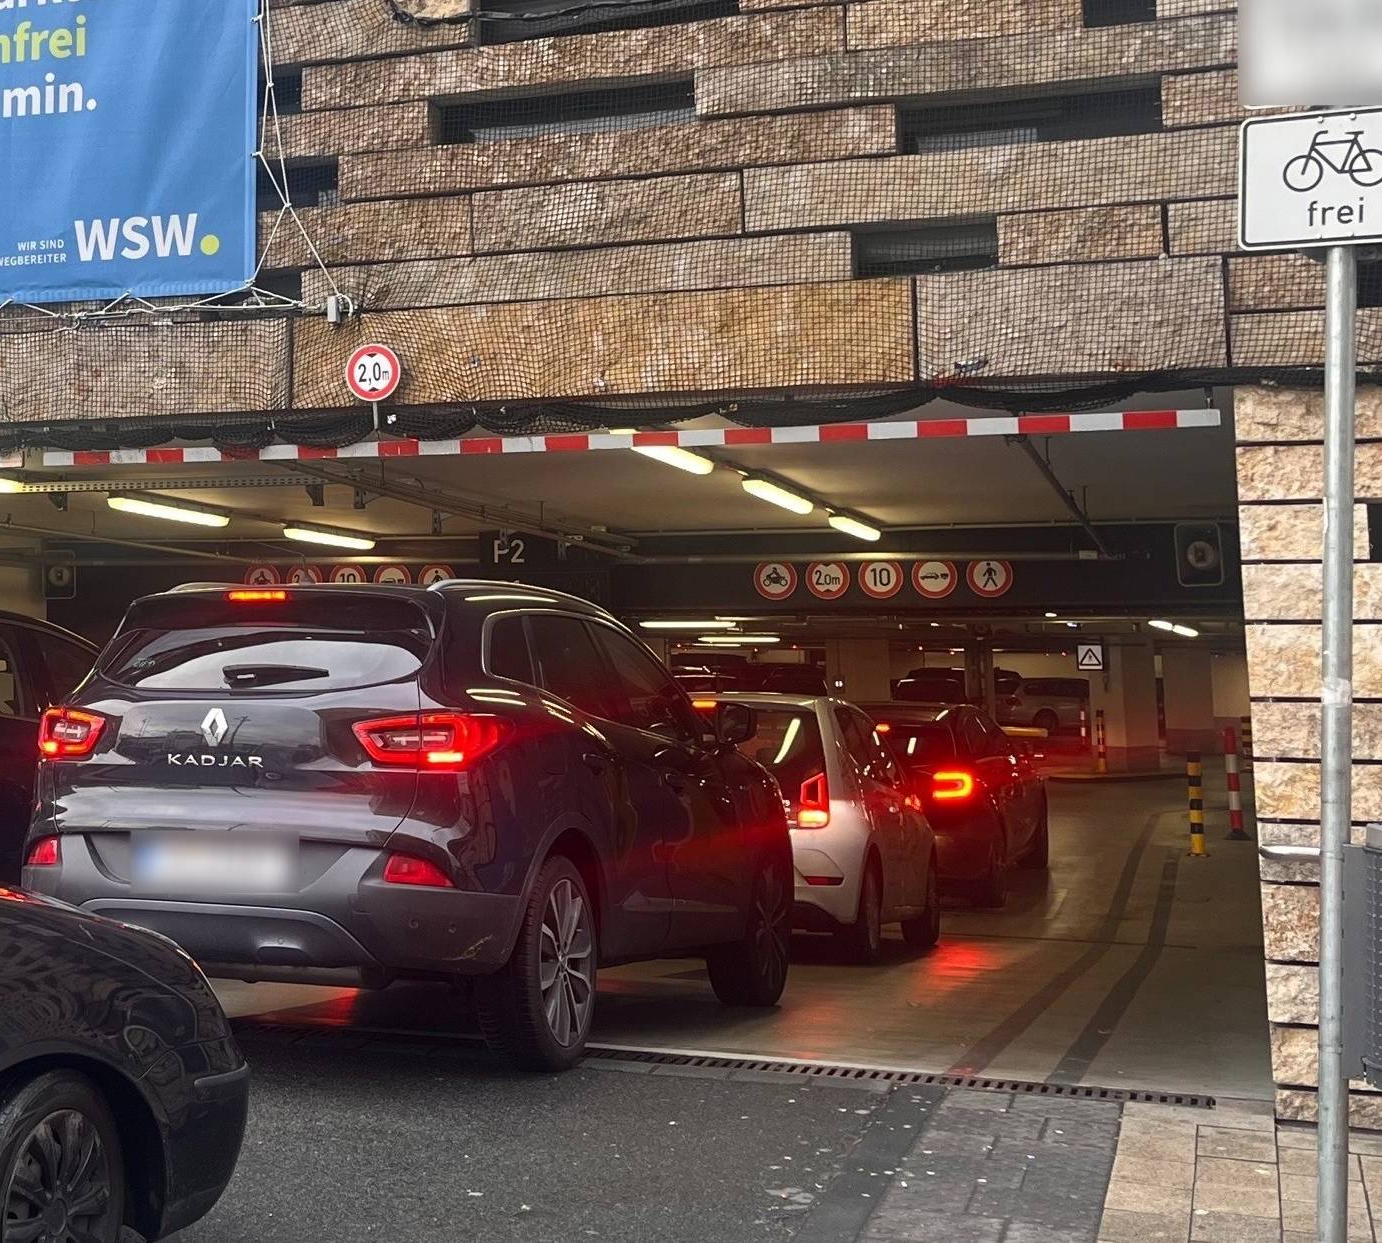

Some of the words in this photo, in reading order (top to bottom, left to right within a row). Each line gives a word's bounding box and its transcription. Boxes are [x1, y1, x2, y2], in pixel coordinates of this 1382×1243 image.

[2, 72, 97, 118] min.
[1307, 197, 1364, 227] frei
[17, 241, 37, 252] WIR
[39, 239, 64, 250] SIND
[870, 567, 891, 587] 10
[167, 753, 264, 768] KADJAR
